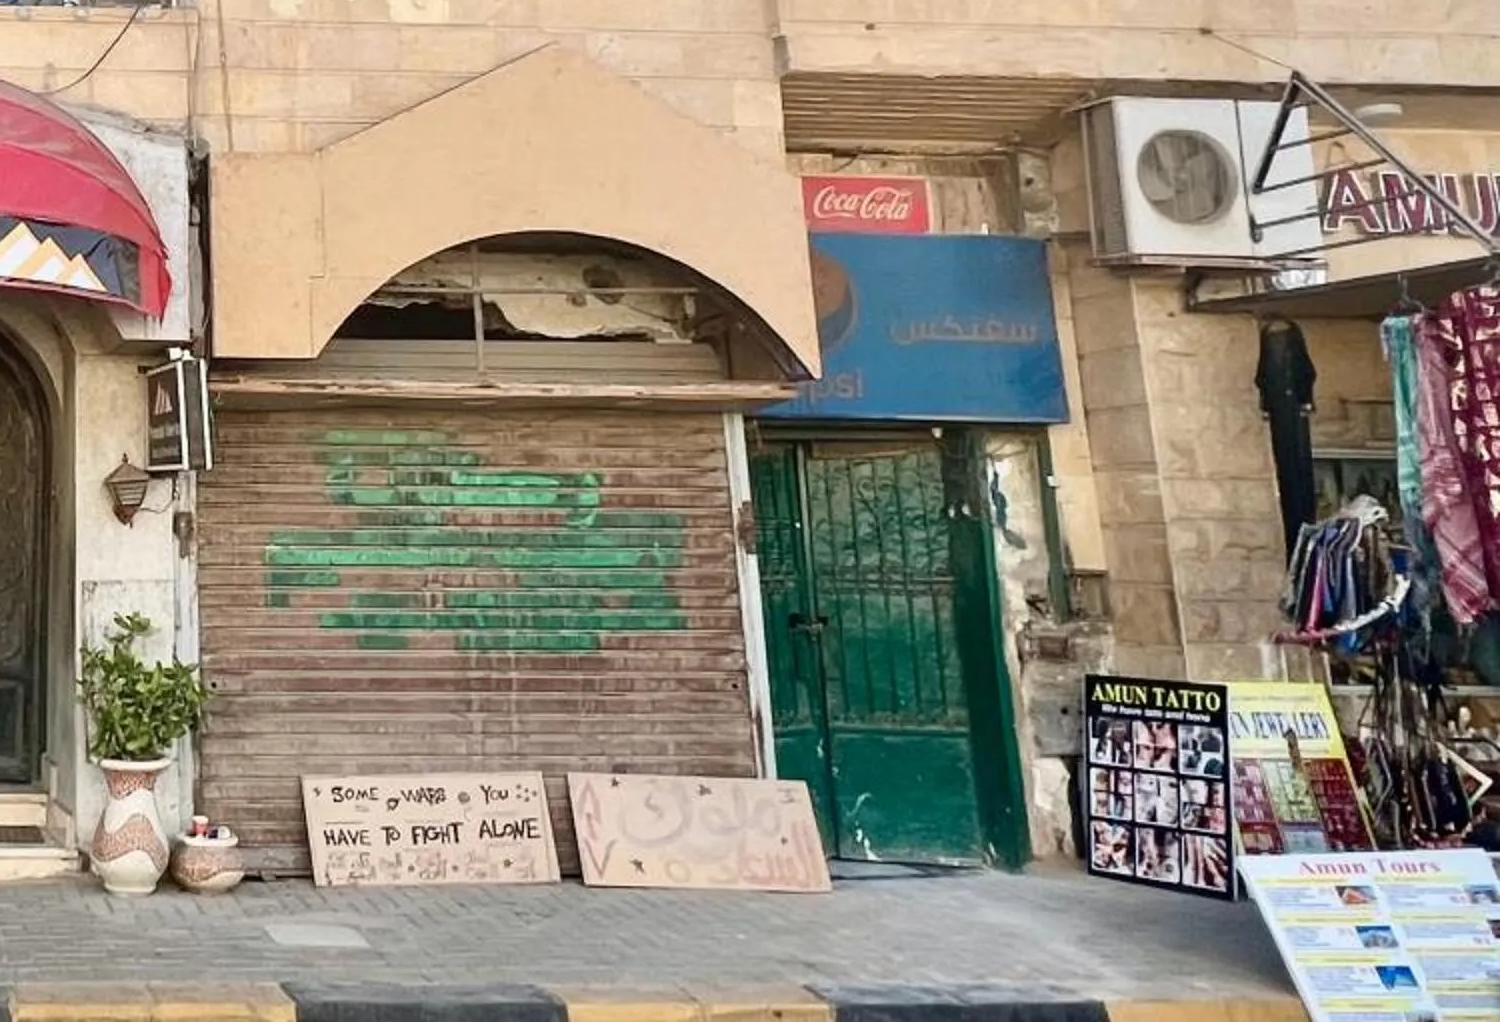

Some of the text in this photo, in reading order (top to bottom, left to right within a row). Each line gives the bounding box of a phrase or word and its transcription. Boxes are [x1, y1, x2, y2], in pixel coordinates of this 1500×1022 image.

[1324, 170, 1500, 235] AMU
[1091, 683, 1221, 712] AMUN TATTO
[331, 786, 379, 803] SOME
[323, 817, 541, 847] HAVE TO FIGHT ALONE
[1299, 858, 1442, 877] Amun Tours
